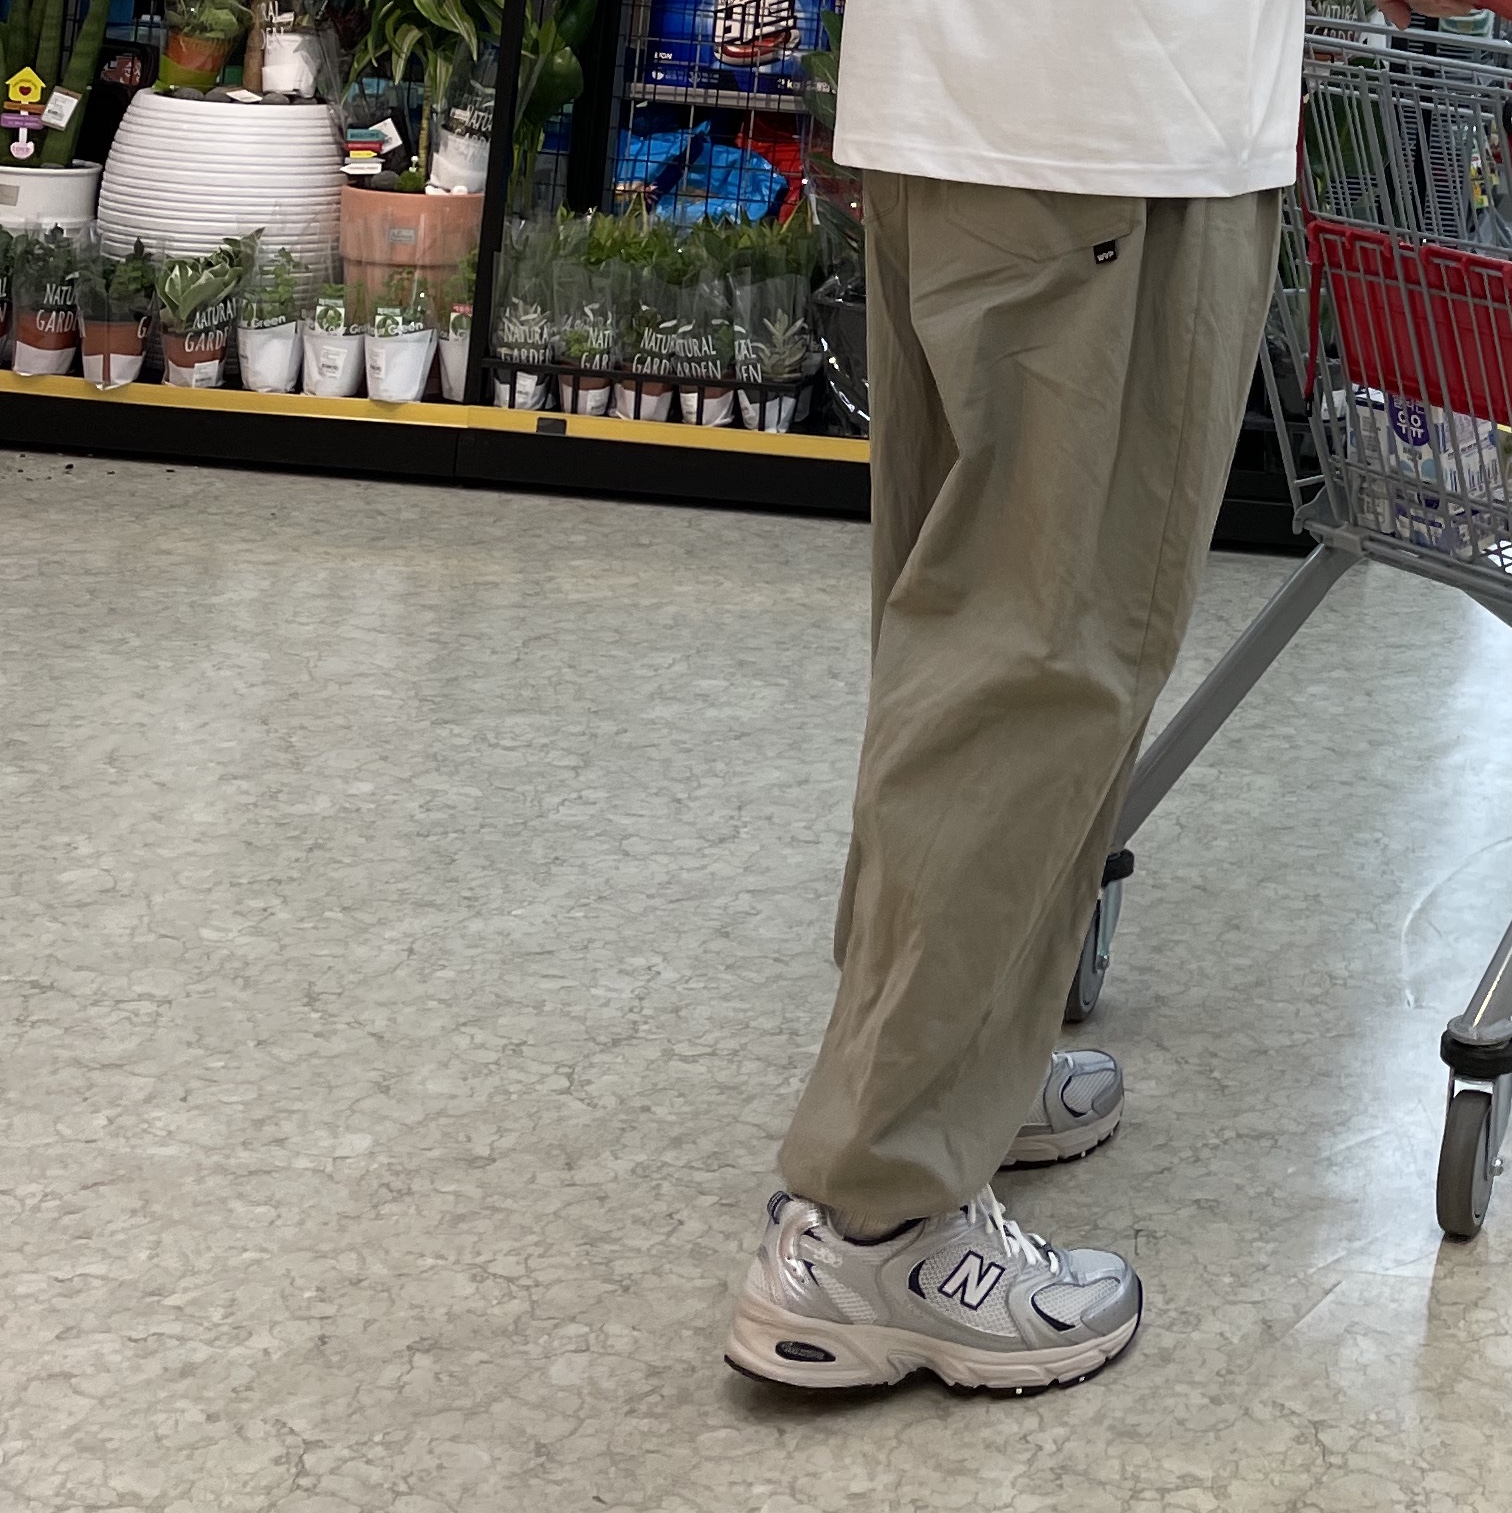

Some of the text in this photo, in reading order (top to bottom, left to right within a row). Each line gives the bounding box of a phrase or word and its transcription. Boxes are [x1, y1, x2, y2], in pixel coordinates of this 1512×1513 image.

[252, 314, 287, 329] Green
[1397, 409, 1425, 439] 우유
[938, 1249, 1005, 1311] N
